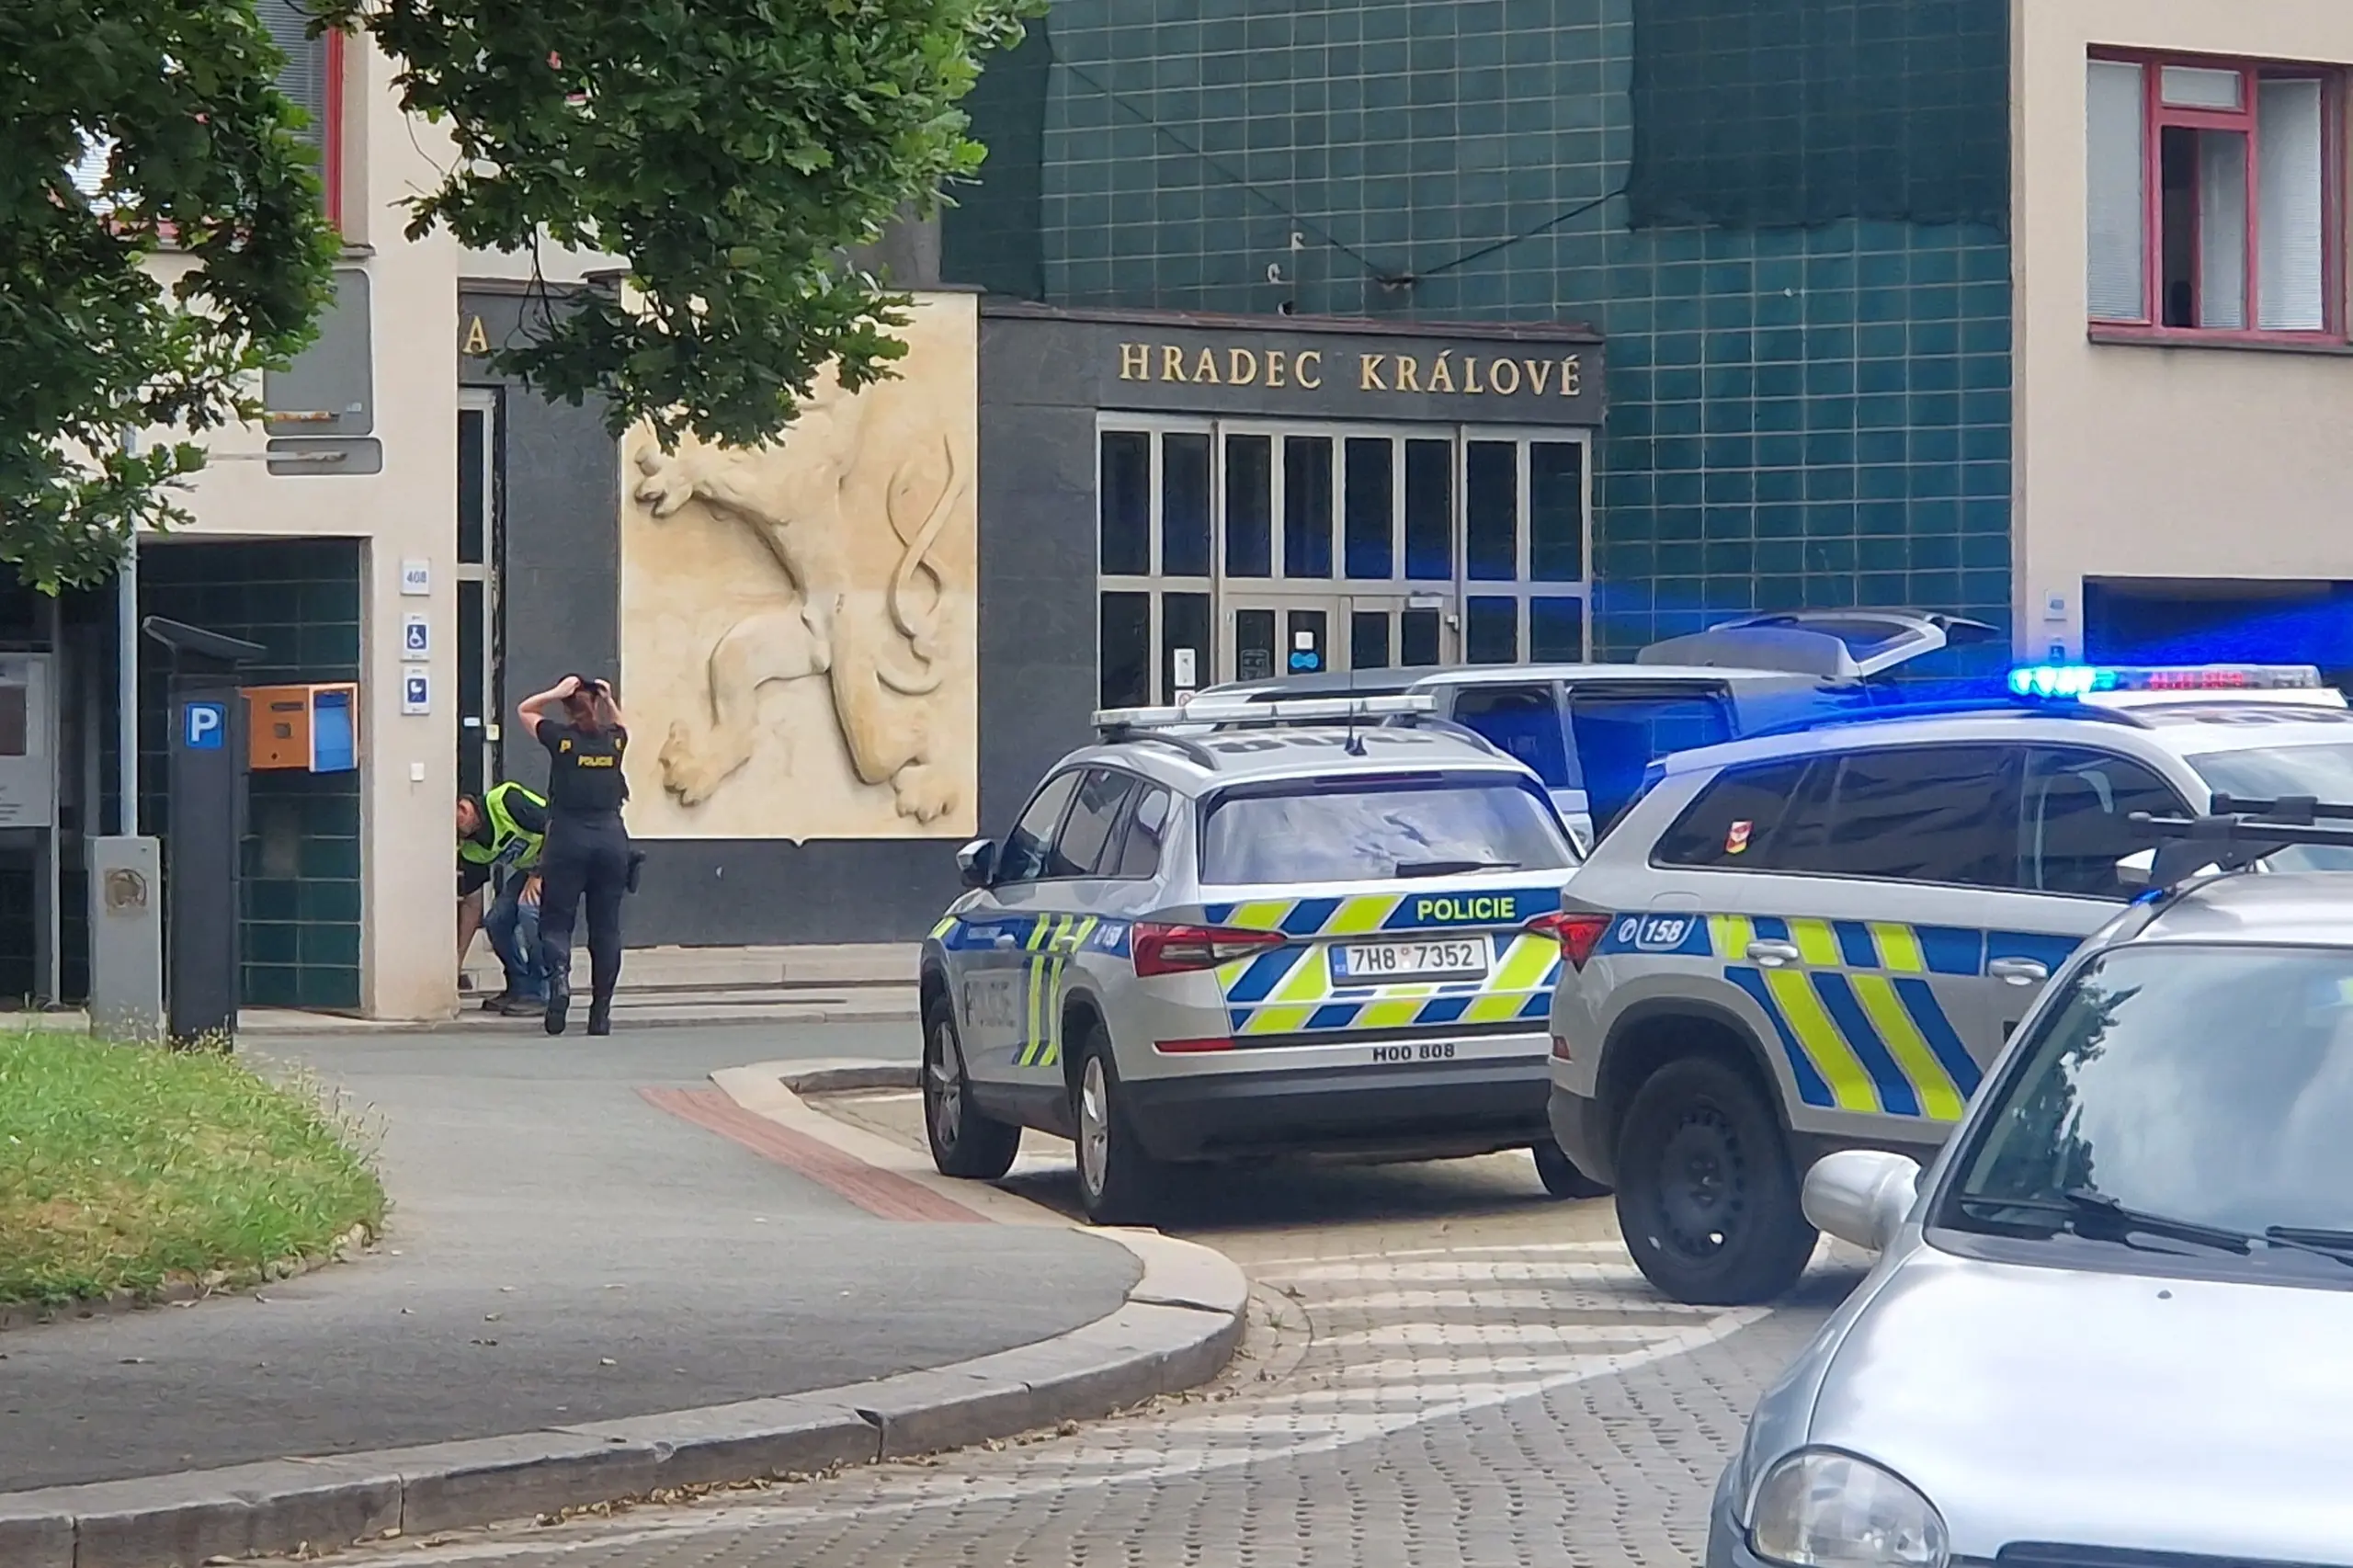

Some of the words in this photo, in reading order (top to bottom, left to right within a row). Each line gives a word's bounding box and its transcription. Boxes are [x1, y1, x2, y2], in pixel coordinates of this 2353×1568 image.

[462, 315, 488, 354] A
[1119, 343, 1322, 390] HRADEC
[1359, 348, 1581, 396] KRÁLOVÉ
[190, 707, 218, 742] P
[1417, 897, 1515, 921] POLICIE
[1645, 919, 1685, 942] 158
[1351, 948, 1396, 971] 7H8
[1414, 943, 1474, 969] 7352
